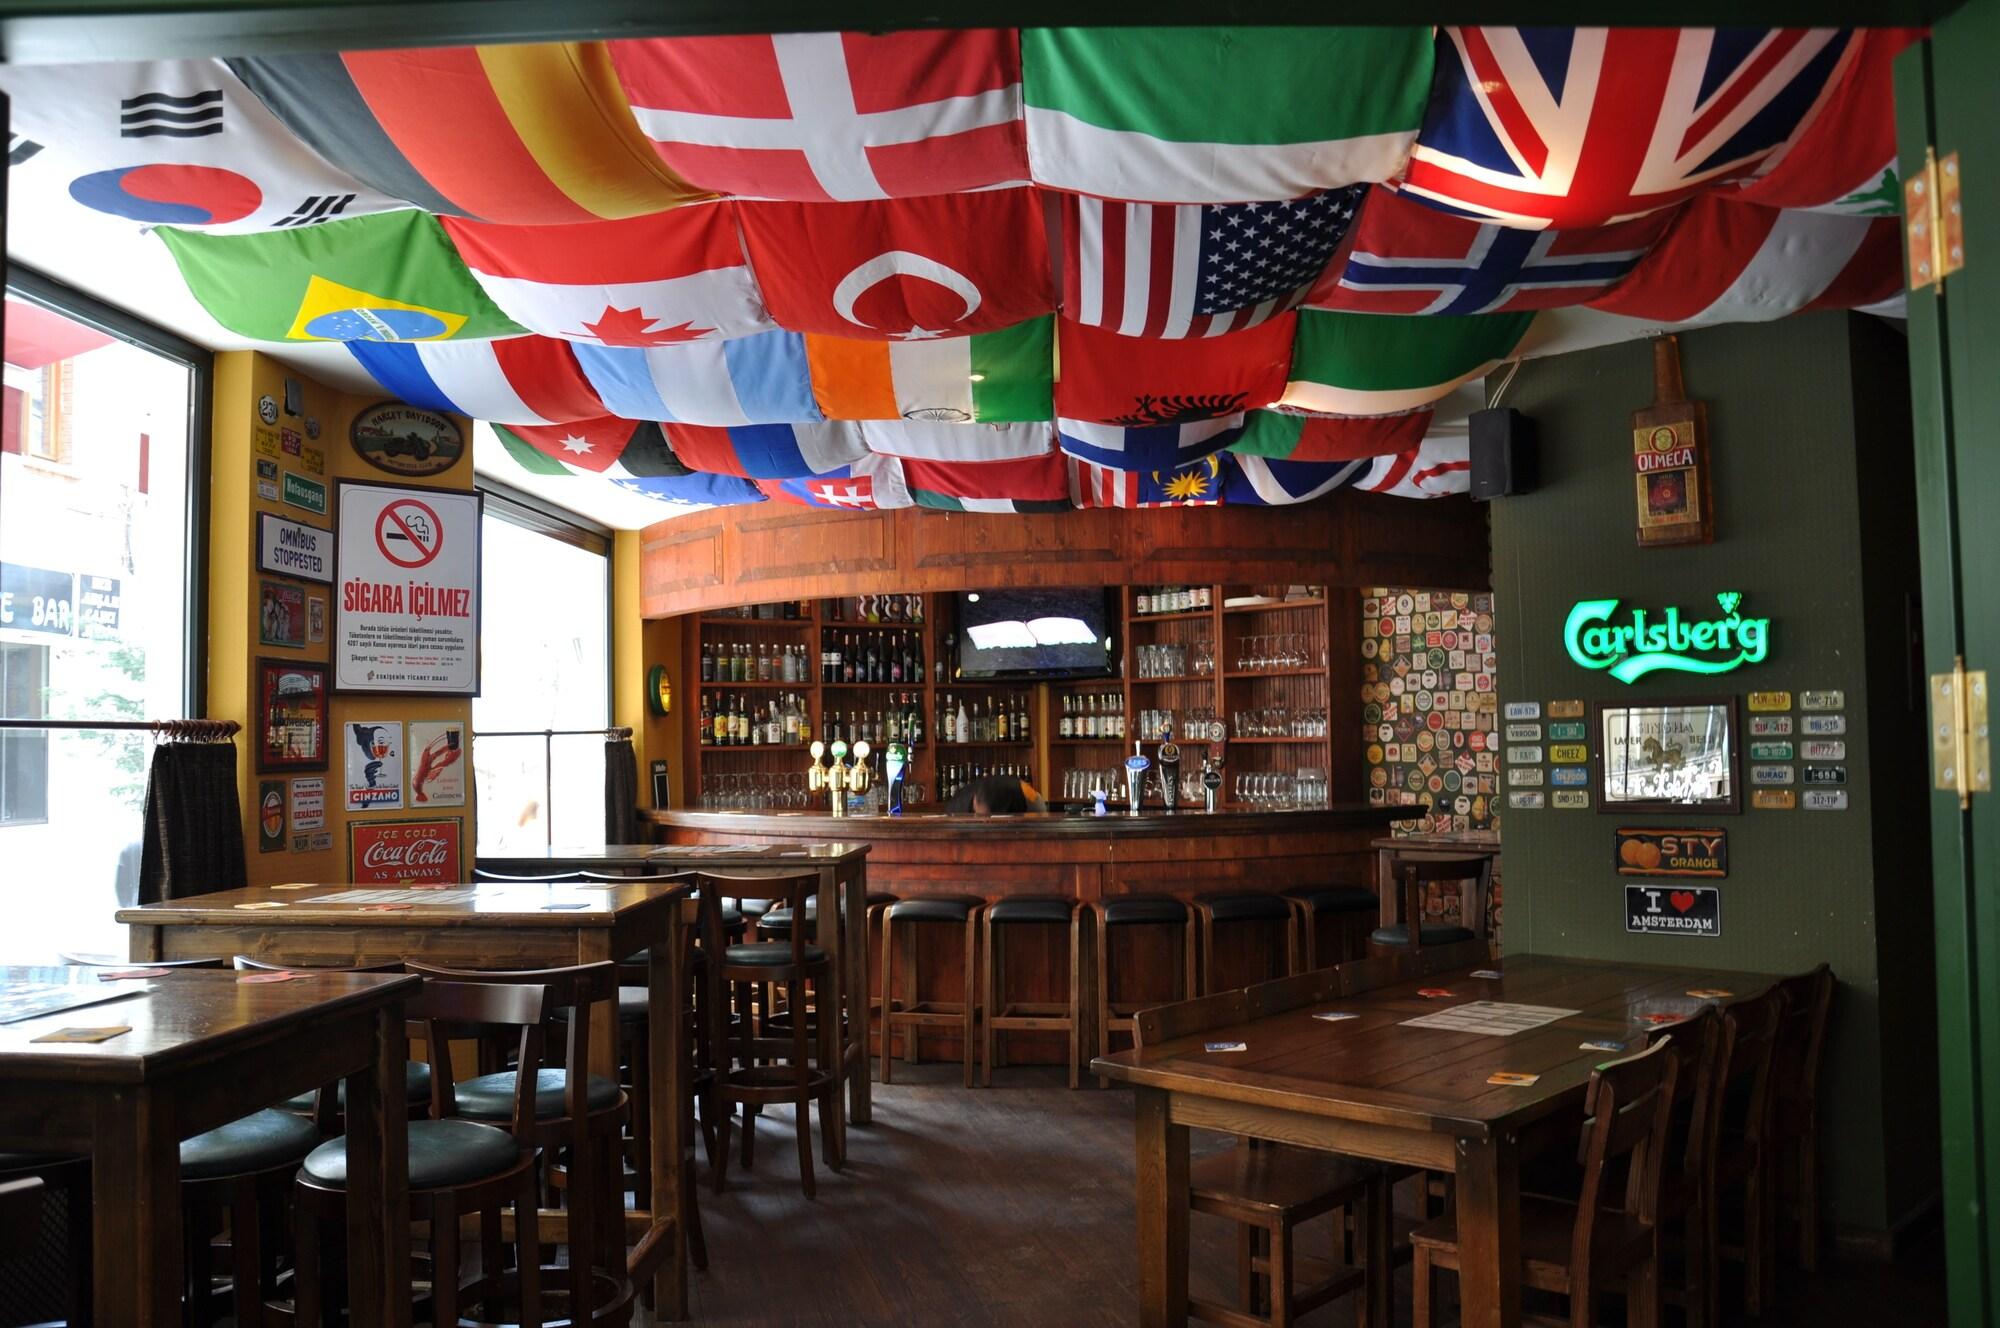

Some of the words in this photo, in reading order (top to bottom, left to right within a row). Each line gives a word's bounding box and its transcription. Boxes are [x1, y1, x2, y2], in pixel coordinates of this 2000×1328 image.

[1637, 450, 1693, 472] OLMECA
[273, 546, 323, 573] STOPPESTED
[343, 577, 404, 615] SİGARA
[408, 580, 471, 622] İÇİLMEZ
[32, 596, 70, 632] BAR
[1563, 598, 1770, 674] Carlsberg
[1556, 748, 1580, 759] CHEEZ
[352, 790, 399, 801] CINZANO
[376, 830, 399, 840] ICE
[404, 828, 437, 839] COLD
[363, 838, 449, 868] Coca-Cola
[1661, 836, 1723, 856] STY
[1669, 857, 1719, 869] ORANGE
[374, 871, 389, 880] AS
[394, 868, 442, 879] ALWAYS
[1646, 890, 1662, 913] I
[1632, 915, 1713, 930] AMSTERDAM
